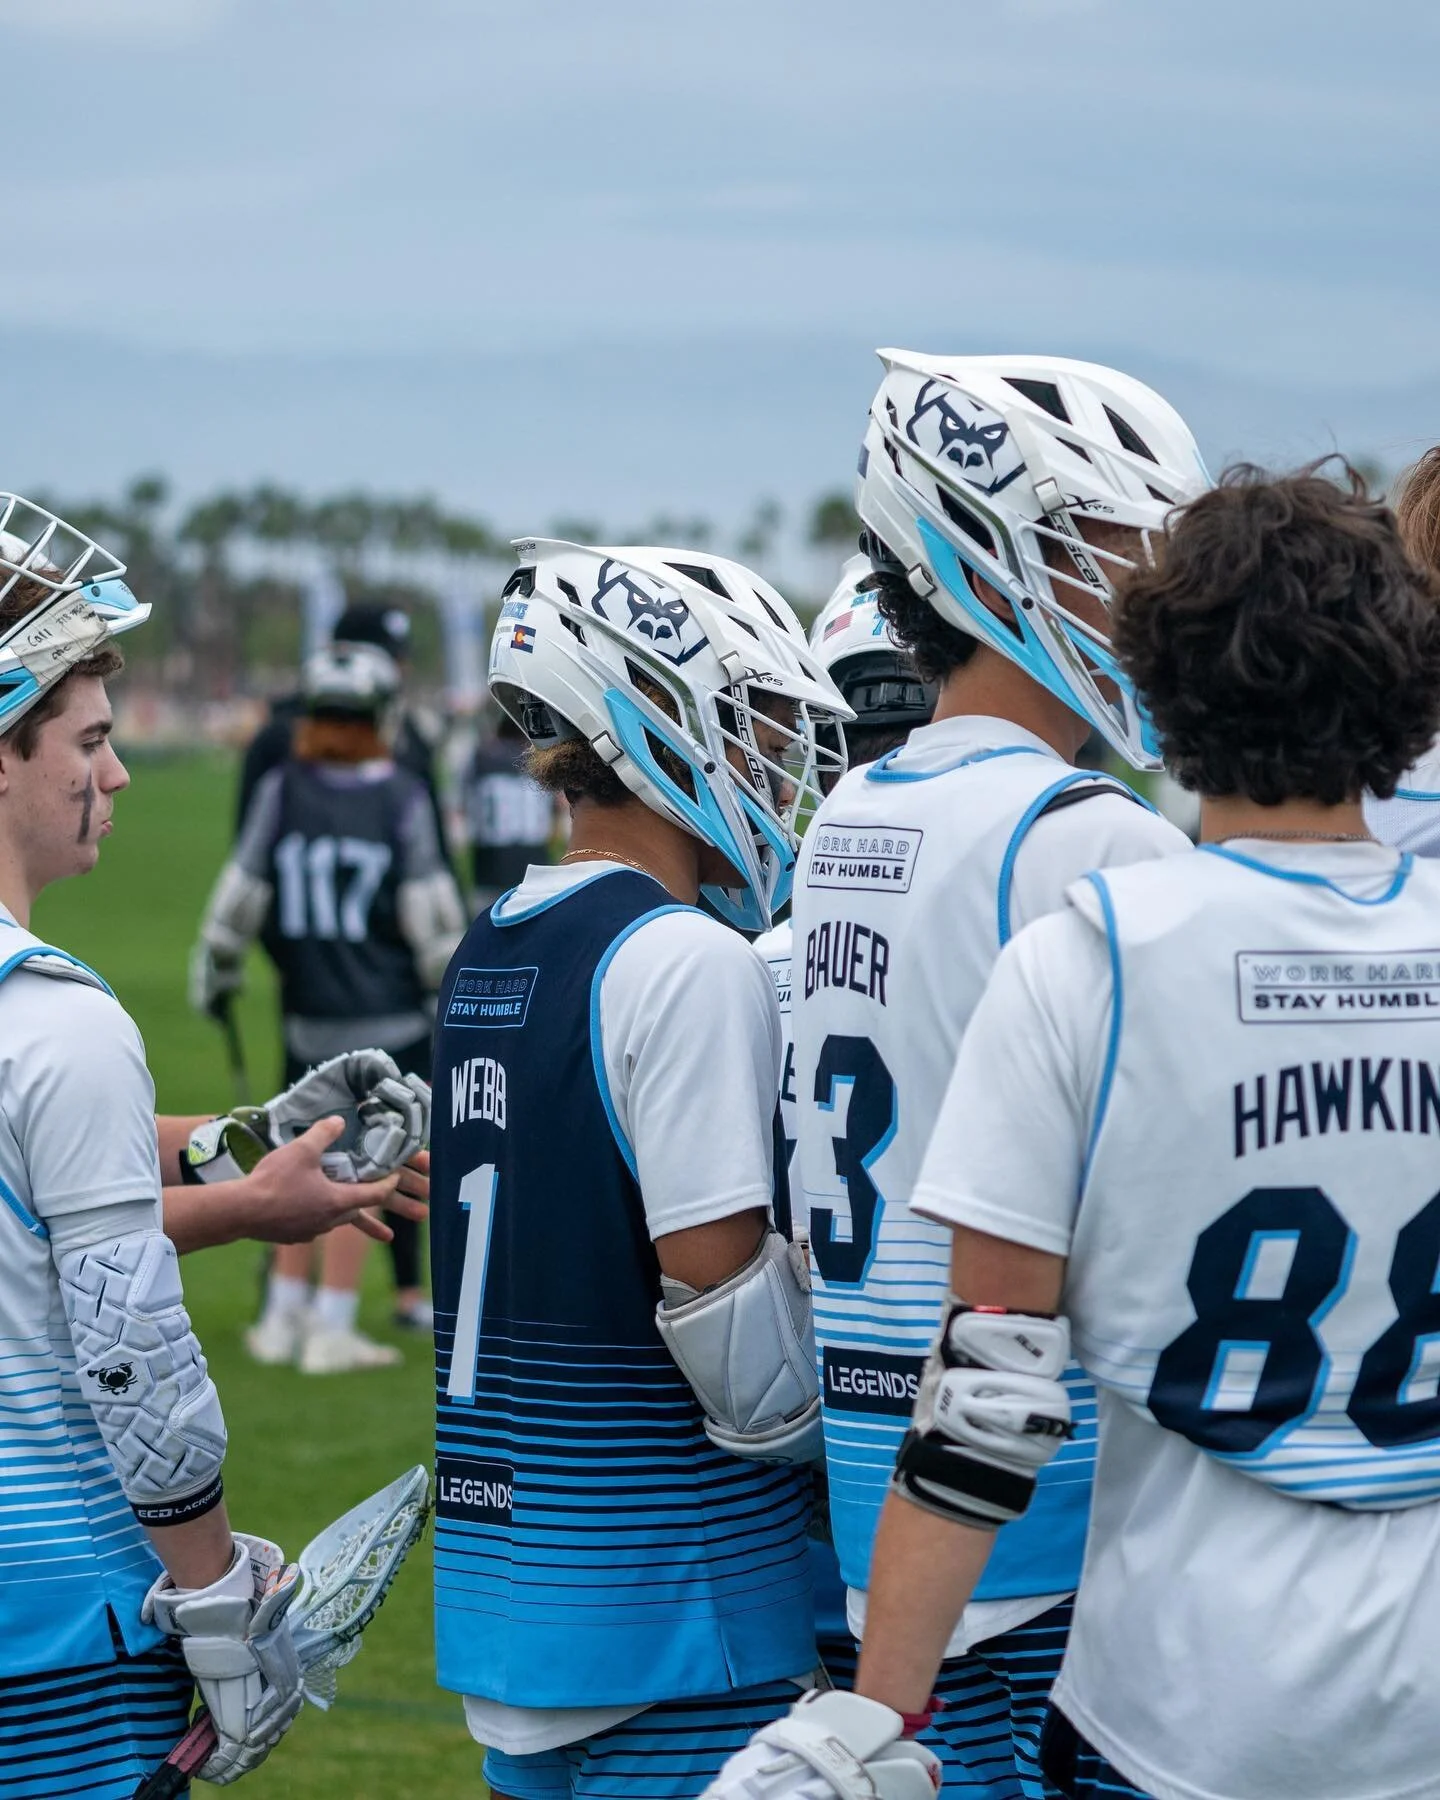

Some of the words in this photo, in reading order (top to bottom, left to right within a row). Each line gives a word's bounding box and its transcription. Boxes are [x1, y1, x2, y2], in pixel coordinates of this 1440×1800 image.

[857, 839, 909, 854] HARD
[838, 864, 904, 880] HUMBLE
[805, 920, 889, 1007] BAUER
[1253, 964, 1354, 982] WORK
[1368, 962, 1440, 982] HAR
[457, 979, 492, 994] WORK
[495, 978, 528, 993] HARD
[1255, 993, 1327, 1009] STAY
[1338, 991, 1440, 1008] HUMBL
[450, 1002, 478, 1016] STAY
[480, 1002, 522, 1017] HUMBLE
[451, 1057, 507, 1131] WEBB
[1234, 1057, 1440, 1160] HAWKIN
[810, 1034, 898, 1290] 3
[447, 1163, 499, 1405] 1
[829, 1365, 920, 1399] LEGENDS
[440, 1475, 513, 1510] LEGENDS
